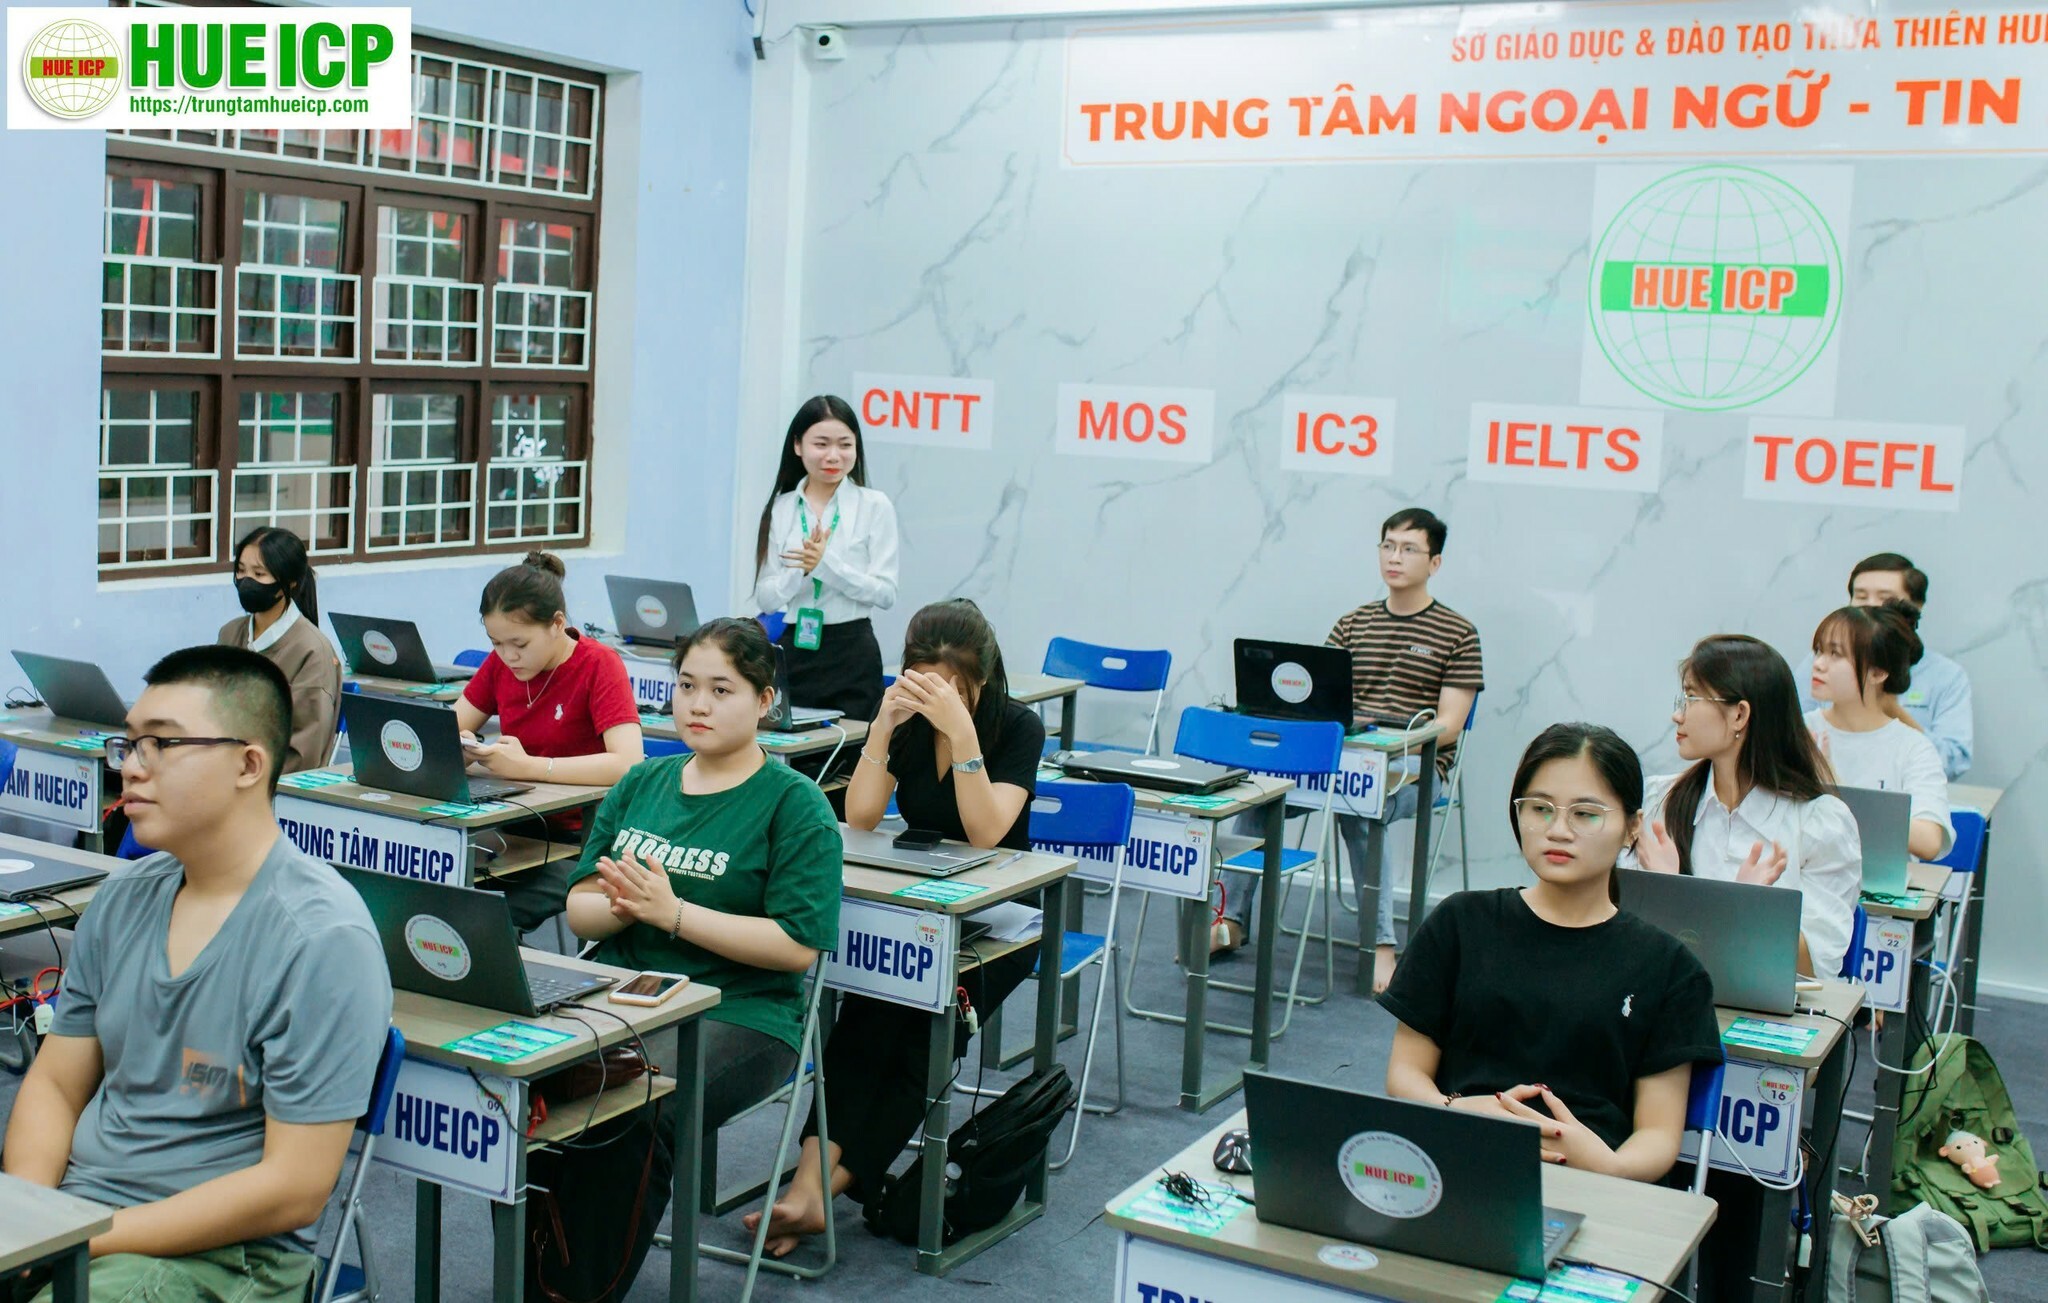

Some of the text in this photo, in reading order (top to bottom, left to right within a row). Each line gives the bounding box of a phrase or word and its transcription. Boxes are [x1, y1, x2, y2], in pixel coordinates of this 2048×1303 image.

[1495, 27, 1559, 61] GIÁO
[1568, 29, 1625, 65] DỤC
[1635, 28, 1656, 56] &
[1736, 22, 1792, 60] TẠO
[1893, 10, 1987, 47] THIÊN
[1080, 69, 2022, 144] TRUNG TÂM NGOẠI NGỮ - TIN
[1632, 267, 1796, 311] HUE ICP
[861, 388, 981, 433] CNTT
[1078, 399, 1188, 445] MOS
[1296, 411, 1379, 457] IC3
[1487, 421, 1641, 473] IELTS
[1753, 435, 1955, 492] TOEFL
[34, 771, 89, 810] HUEICP
[279, 818, 454, 884] TRUNG TÂM HUEICP
[612, 829, 730, 876] PROGRESS
[1123, 837, 1198, 876] HUEICP
[846, 930, 933, 983] HUEICP
[925, 933, 934, 943] 15
[1887, 939, 1899, 947] 22
[1861, 948, 1894, 984] CP
[487, 1100, 500, 1112] 09
[1771, 1090, 1786, 1101] 16
[395, 1092, 500, 1163] HUEICP
[1719, 1095, 1780, 1147] ICP
[1365, 1164, 1415, 1187] HUE ICP
